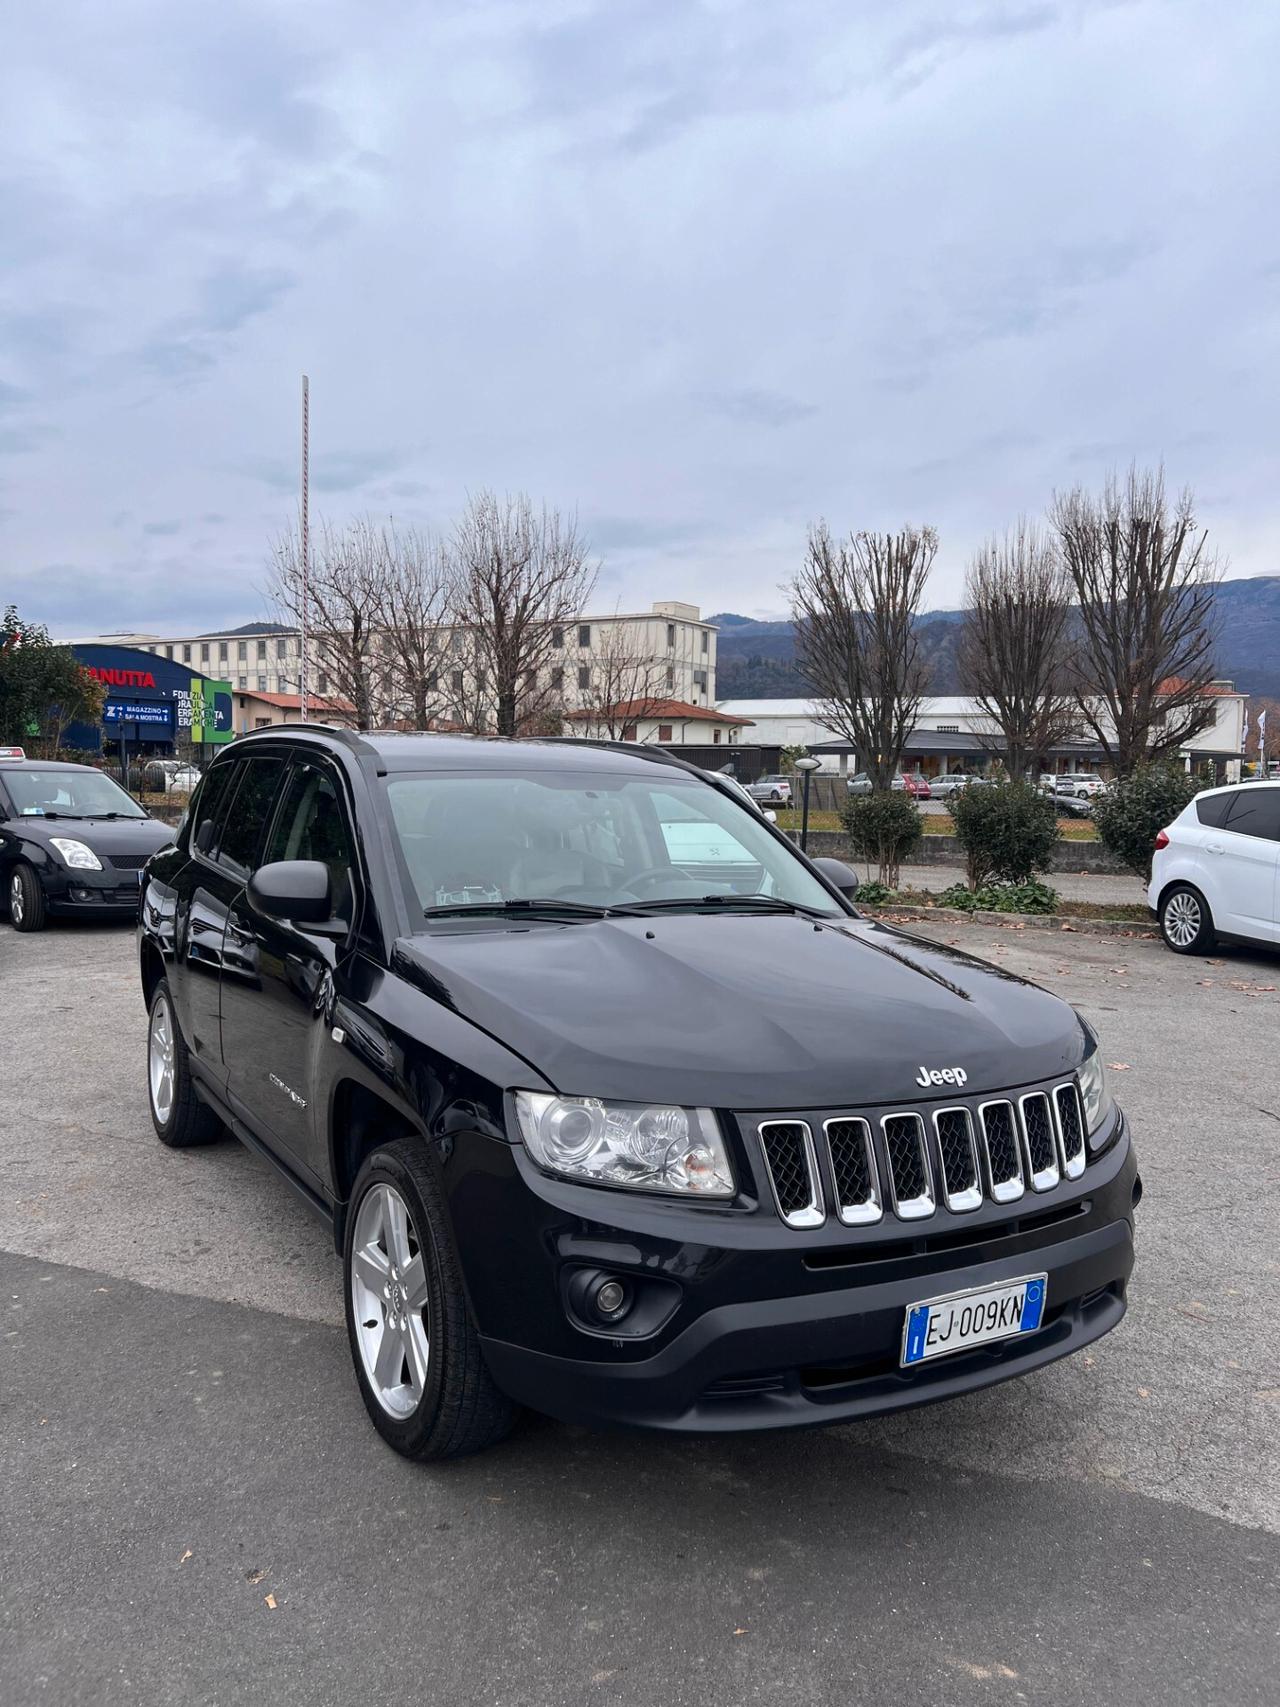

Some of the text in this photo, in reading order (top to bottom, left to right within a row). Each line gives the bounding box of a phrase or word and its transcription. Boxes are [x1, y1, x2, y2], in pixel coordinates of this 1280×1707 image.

[80, 667, 156, 688] ANUTTA
[126, 706, 162, 714] MAGAZZINO
[177, 709, 224, 720] ERRAMENTA
[915, 1066, 968, 1088] Jeep
